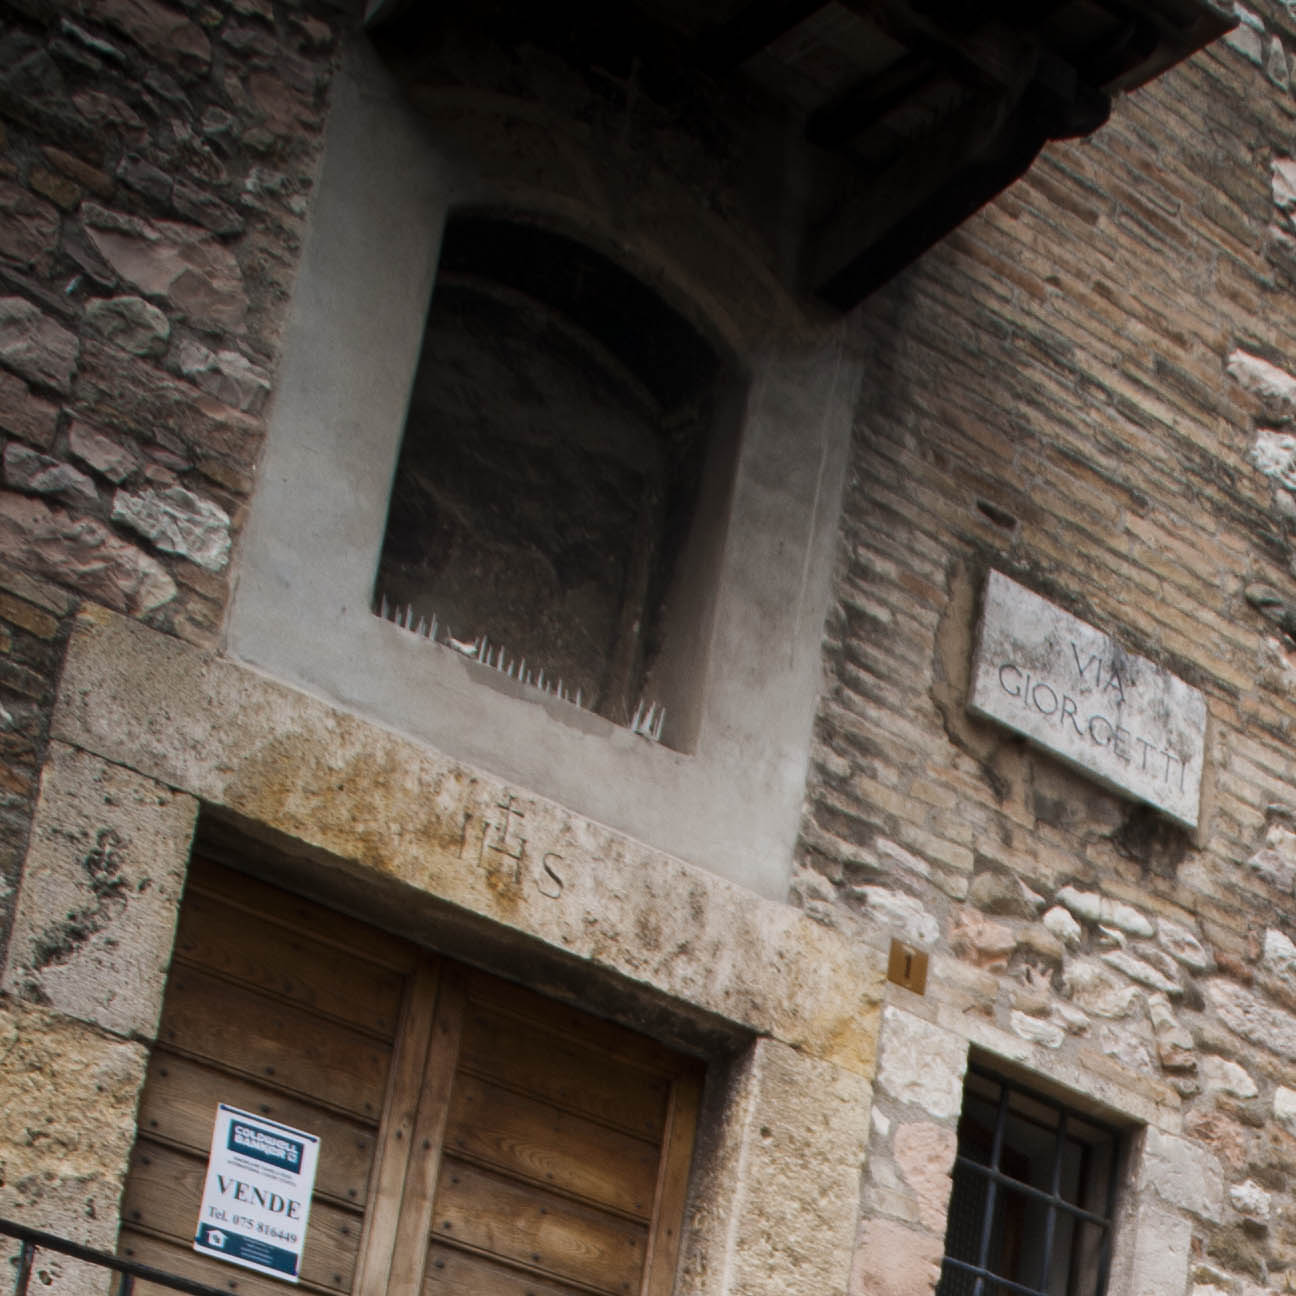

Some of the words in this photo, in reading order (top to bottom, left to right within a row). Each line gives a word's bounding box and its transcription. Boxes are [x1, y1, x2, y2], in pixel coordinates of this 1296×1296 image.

[1071, 642, 1126, 703] VIA
[998, 663, 1188, 794] GIORGETTI
[208, 1206, 228, 1222] Tel.
[232, 1214, 254, 1230] 075
[217, 1174, 301, 1220] VENDE
